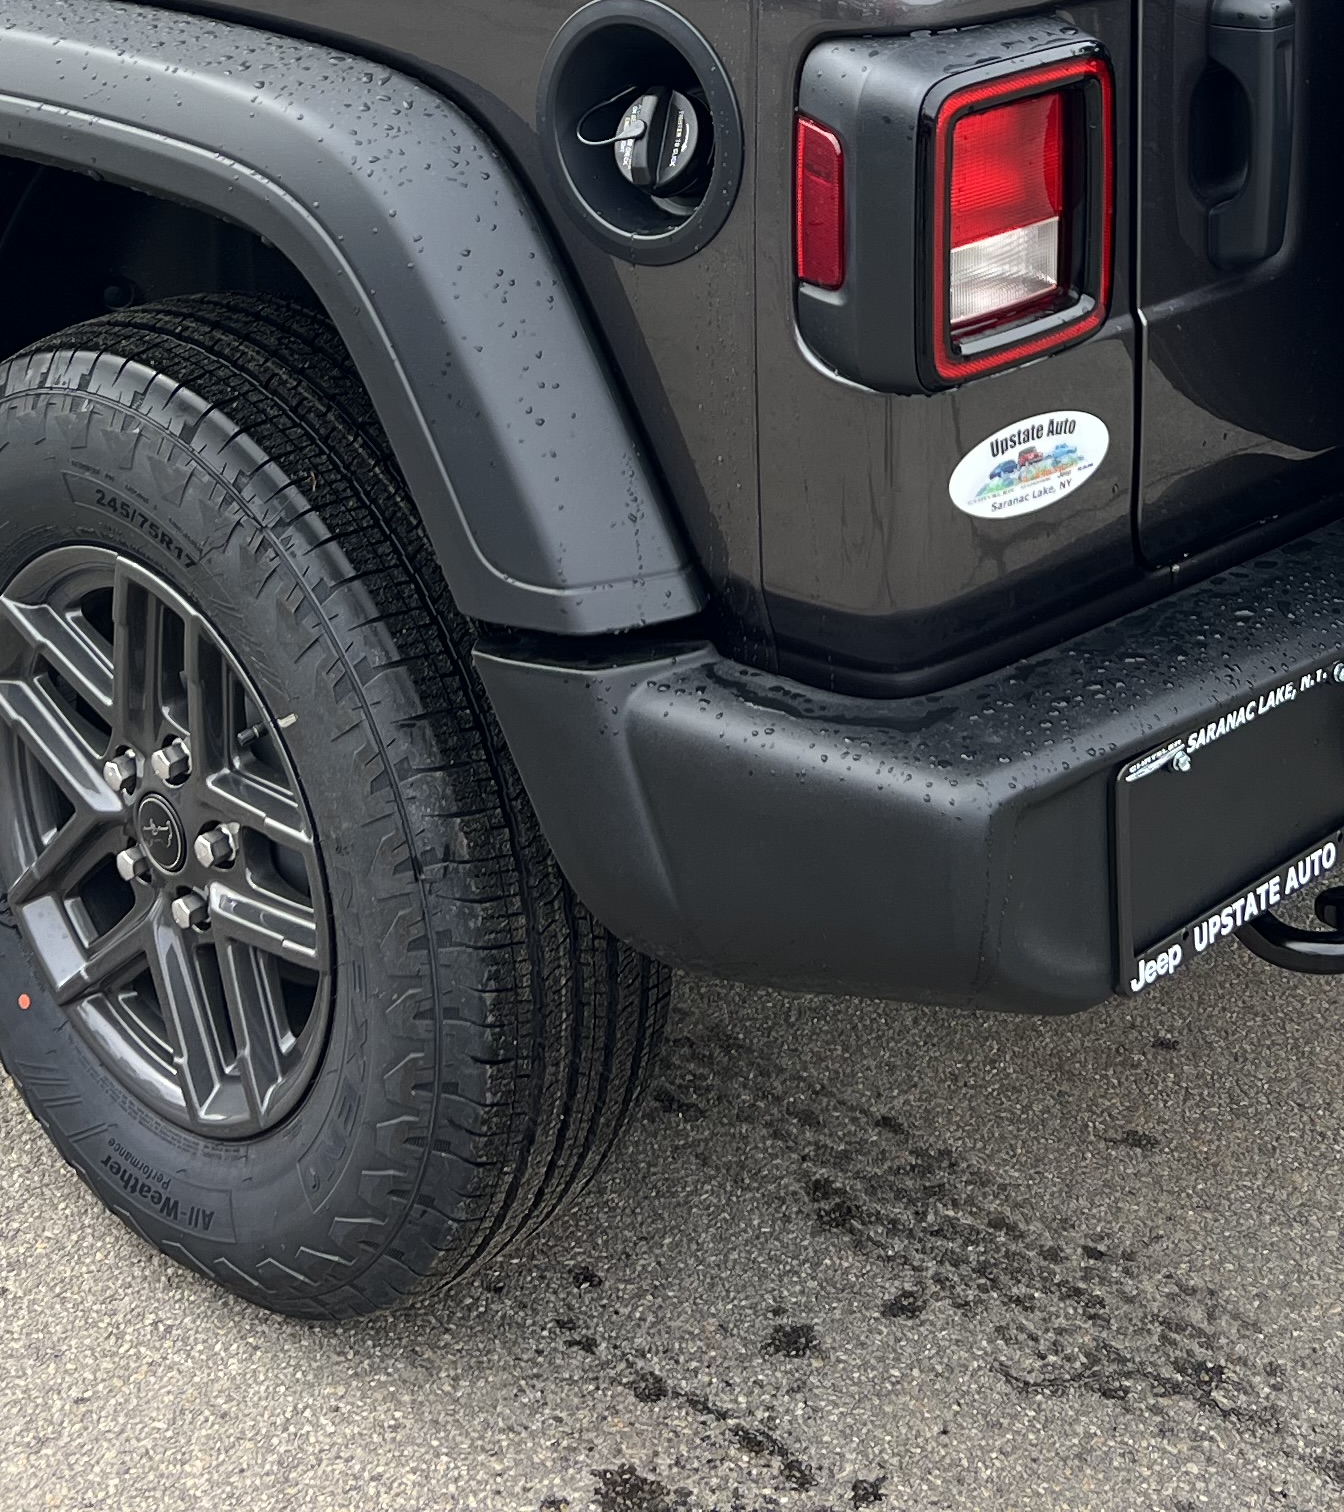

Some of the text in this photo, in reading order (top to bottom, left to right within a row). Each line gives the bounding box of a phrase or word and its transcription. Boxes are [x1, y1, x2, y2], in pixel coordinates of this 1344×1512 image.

[989, 418, 1077, 458] Upstate Auto
[96, 489, 197, 569] 245/75R17
[991, 493, 1029, 512] Saranac
[1032, 486, 1056, 500] Lake,
[1059, 478, 1072, 490] NY
[1186, 701, 1257, 754] SARANAC
[1258, 682, 1297, 715] LAKE,
[1130, 943, 1183, 992] Jeep
[1193, 875, 1281, 952] UPSTATE
[1285, 842, 1337, 895] AUTO
[100, 1153, 216, 1232] All-Weather
[106, 1138, 173, 1191] Performance
